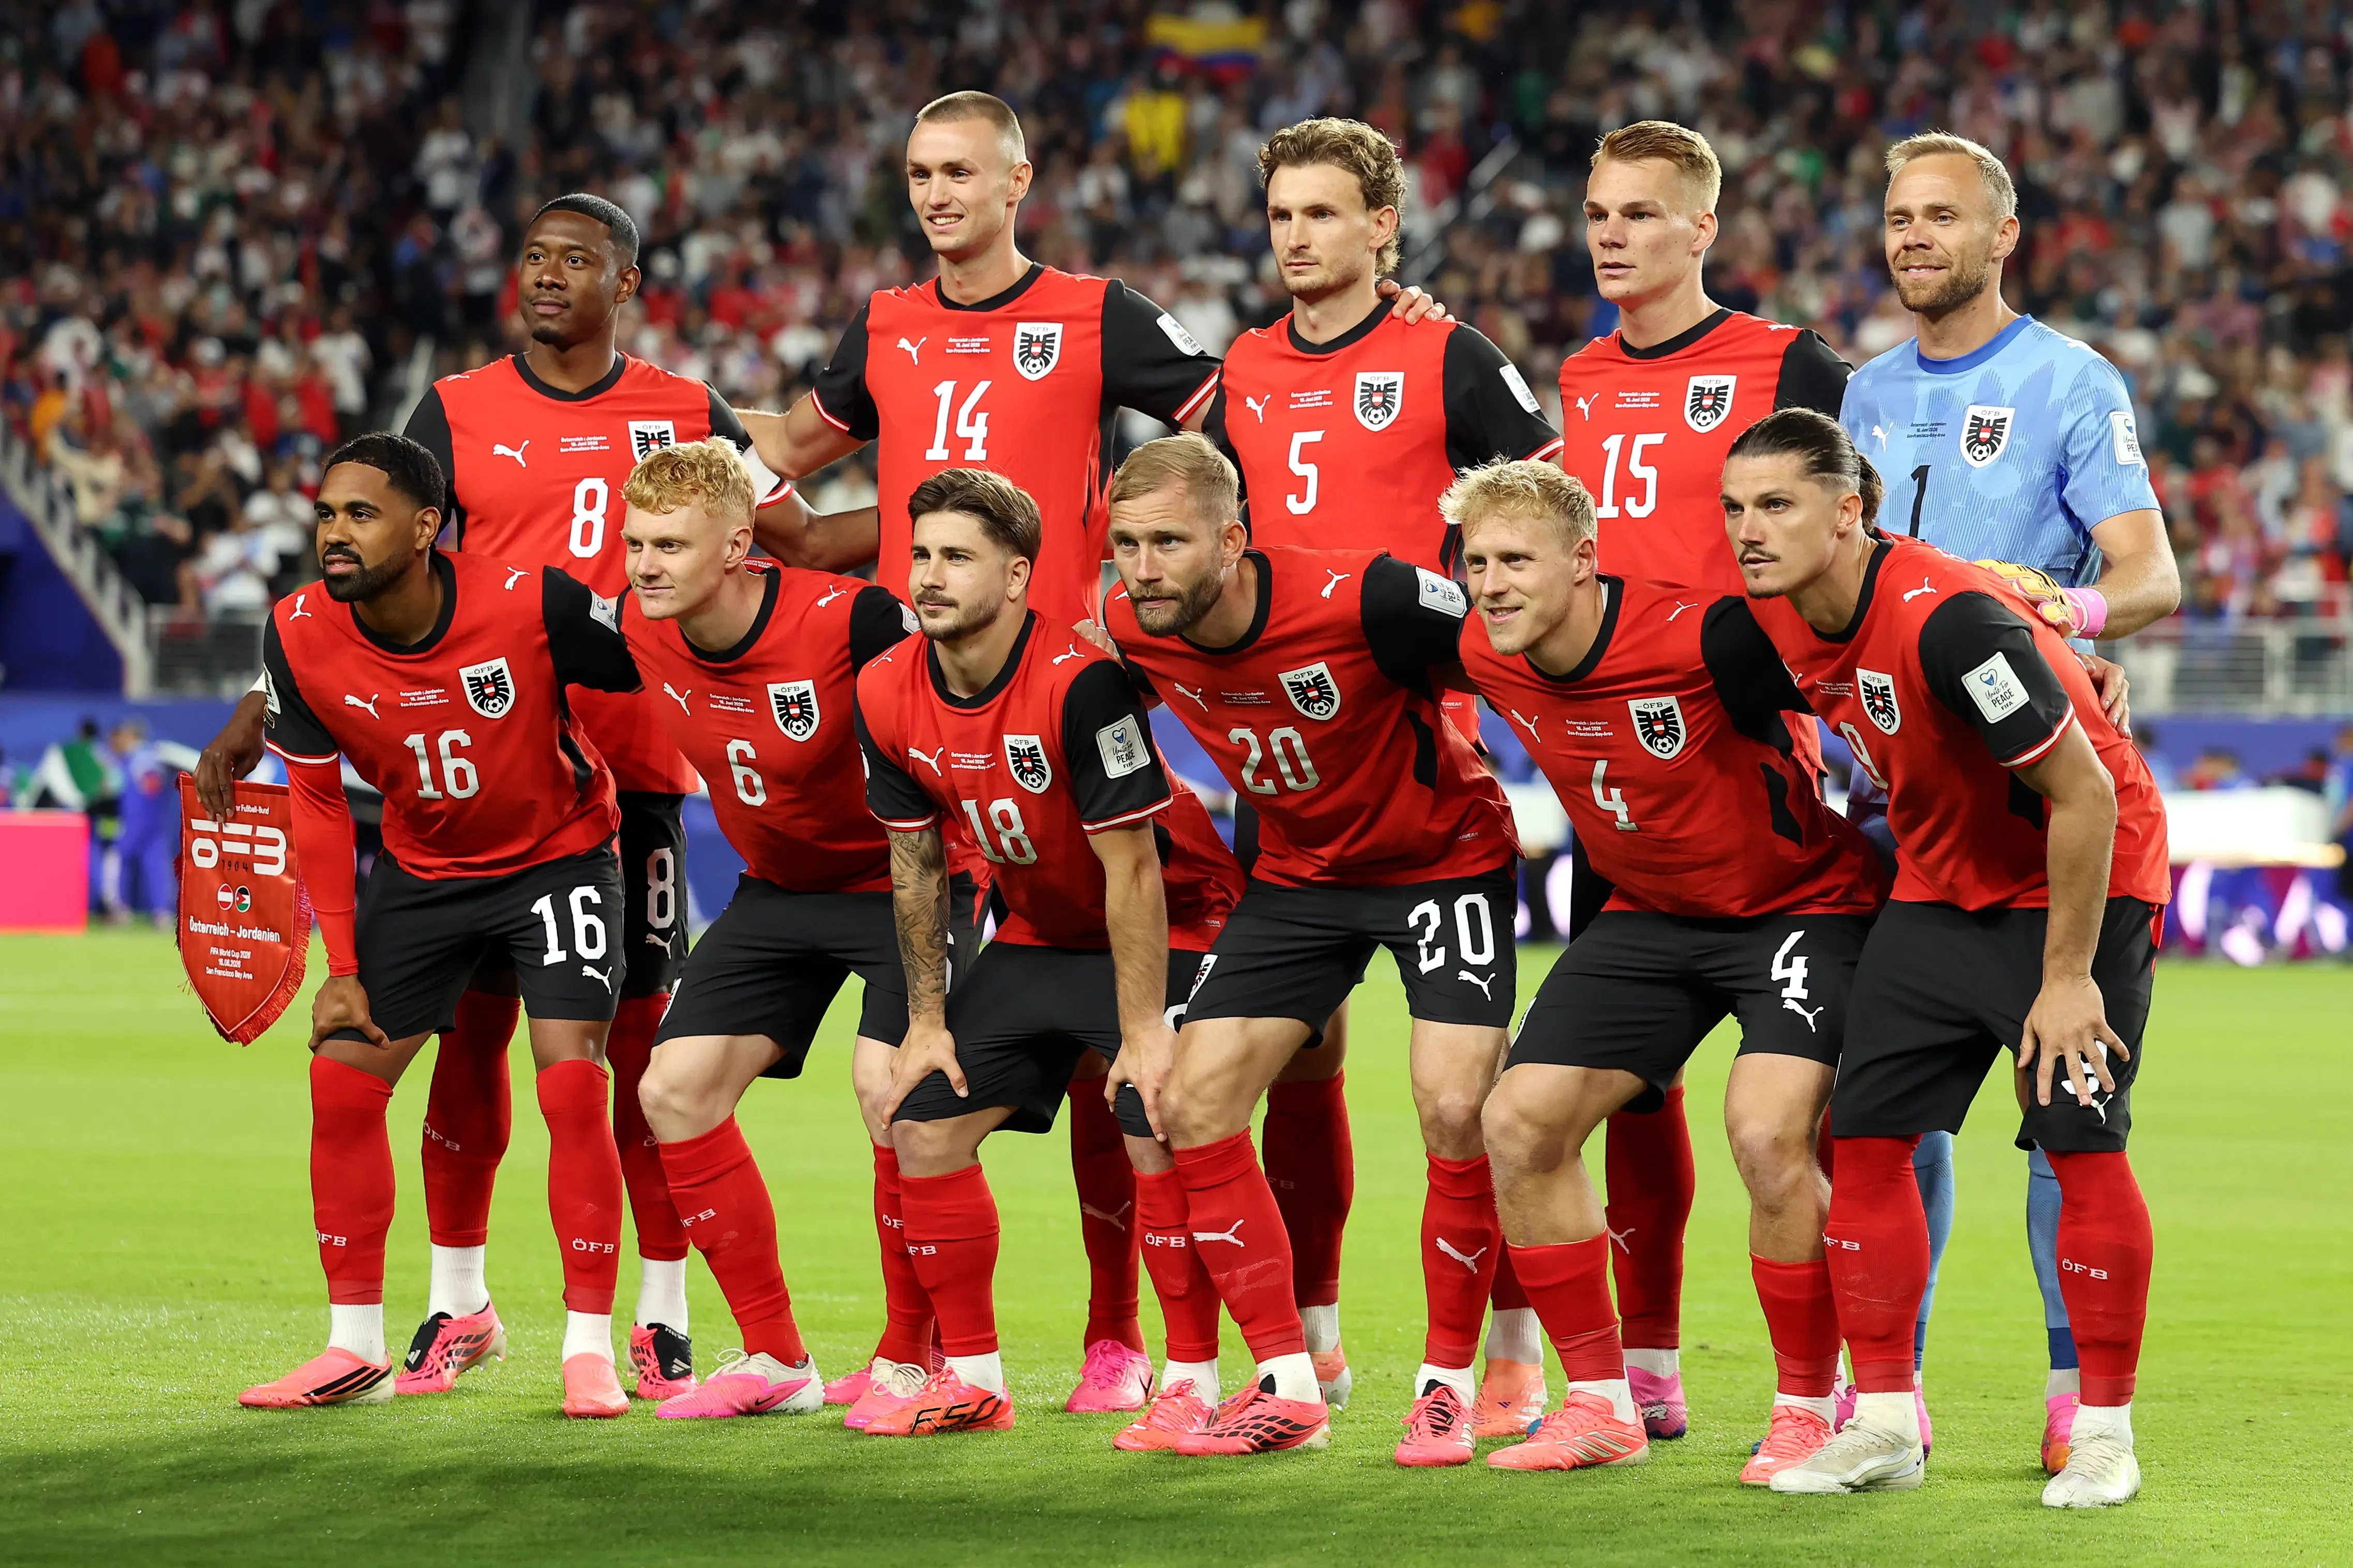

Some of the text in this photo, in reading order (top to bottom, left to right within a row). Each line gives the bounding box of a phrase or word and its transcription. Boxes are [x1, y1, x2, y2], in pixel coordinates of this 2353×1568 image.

[925, 381, 992, 460] 14
[1286, 430, 1326, 515] 5
[1596, 432, 1668, 519] 15
[1909, 465, 1932, 542] 1
[568, 477, 609, 558] 8
[474, 665, 493, 674] ÖFB
[1294, 670, 1313, 680] ÖFB
[1867, 674, 1882, 684] ÖFB
[1985, 686, 2001, 700] Unite
[1991, 688, 2015, 708] PEACE
[2001, 701, 2013, 711] FIFA
[1112, 745, 1128, 756] Unite
[1116, 749, 1135, 764] PEACE
[1228, 726, 1320, 794] 20
[403, 729, 479, 800] 16
[726, 738, 767, 807] 6
[1591, 760, 1638, 831] 4
[241, 804, 270, 815] Fußball-Bund
[961, 797, 1038, 865] 18
[221, 860, 248, 872] 1904
[647, 847, 675, 929] 8
[189, 915, 229, 937] Österreich
[236, 925, 280, 942] Jordanien
[530, 885, 606, 967] 16
[1407, 893, 1495, 975] 20
[210, 946, 251, 960] FIFA World Cup 2026
[206, 966, 253, 980] San Francisco Bay Area
[1771, 930, 1809, 1000] 4
[424, 1121, 460, 1151] ÖFB
[1266, 1177, 1294, 1189] FB
[681, 1208, 717, 1229] FB
[882, 1214, 904, 1229] ÖF
[572, 1238, 615, 1254] ÖFB
[906, 1244, 937, 1256] FB
[1145, 1232, 1186, 1248] ÖFB
[2062, 1258, 2108, 1279] ÖFB
[911, 1392, 1005, 1435] F50
